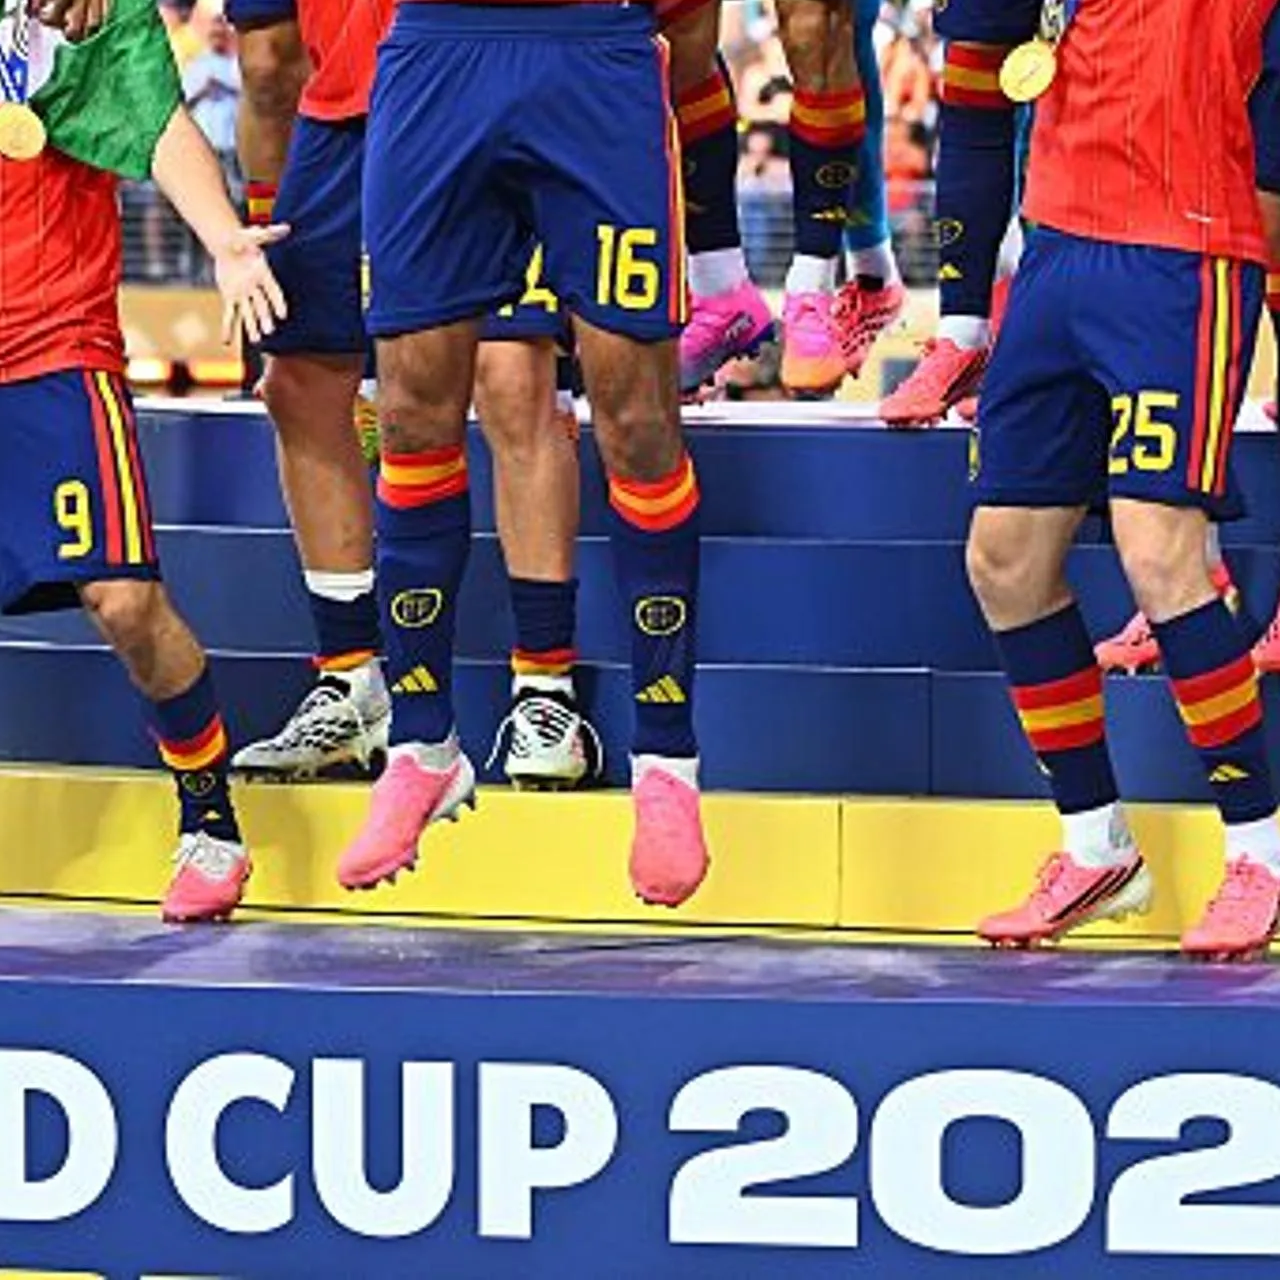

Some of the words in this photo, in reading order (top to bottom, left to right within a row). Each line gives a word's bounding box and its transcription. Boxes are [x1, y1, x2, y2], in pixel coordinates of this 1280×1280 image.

[597, 224, 659, 310] 16
[1108, 390, 1179, 475] 25
[55, 480, 92, 559] 9
[166, 1053, 618, 1239] CUP
